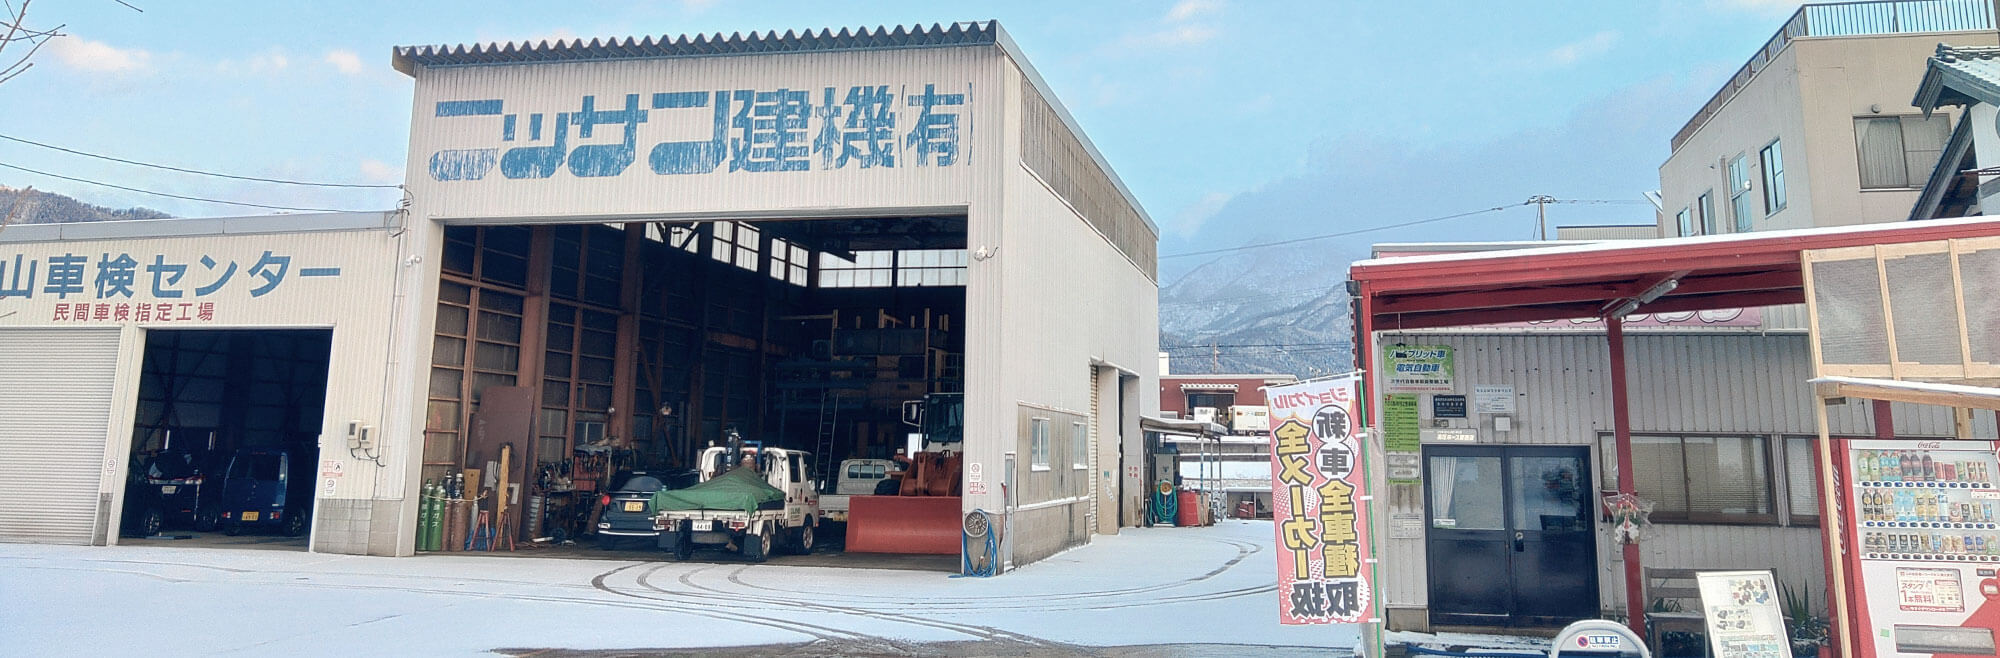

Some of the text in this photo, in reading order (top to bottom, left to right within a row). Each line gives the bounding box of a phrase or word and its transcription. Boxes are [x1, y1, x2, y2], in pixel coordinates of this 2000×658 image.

[0, 251, 341, 299] 山車検センター
[53, 302, 215, 322] 民間車検指定工場
[1396, 363, 1440, 372] 電気自動車
